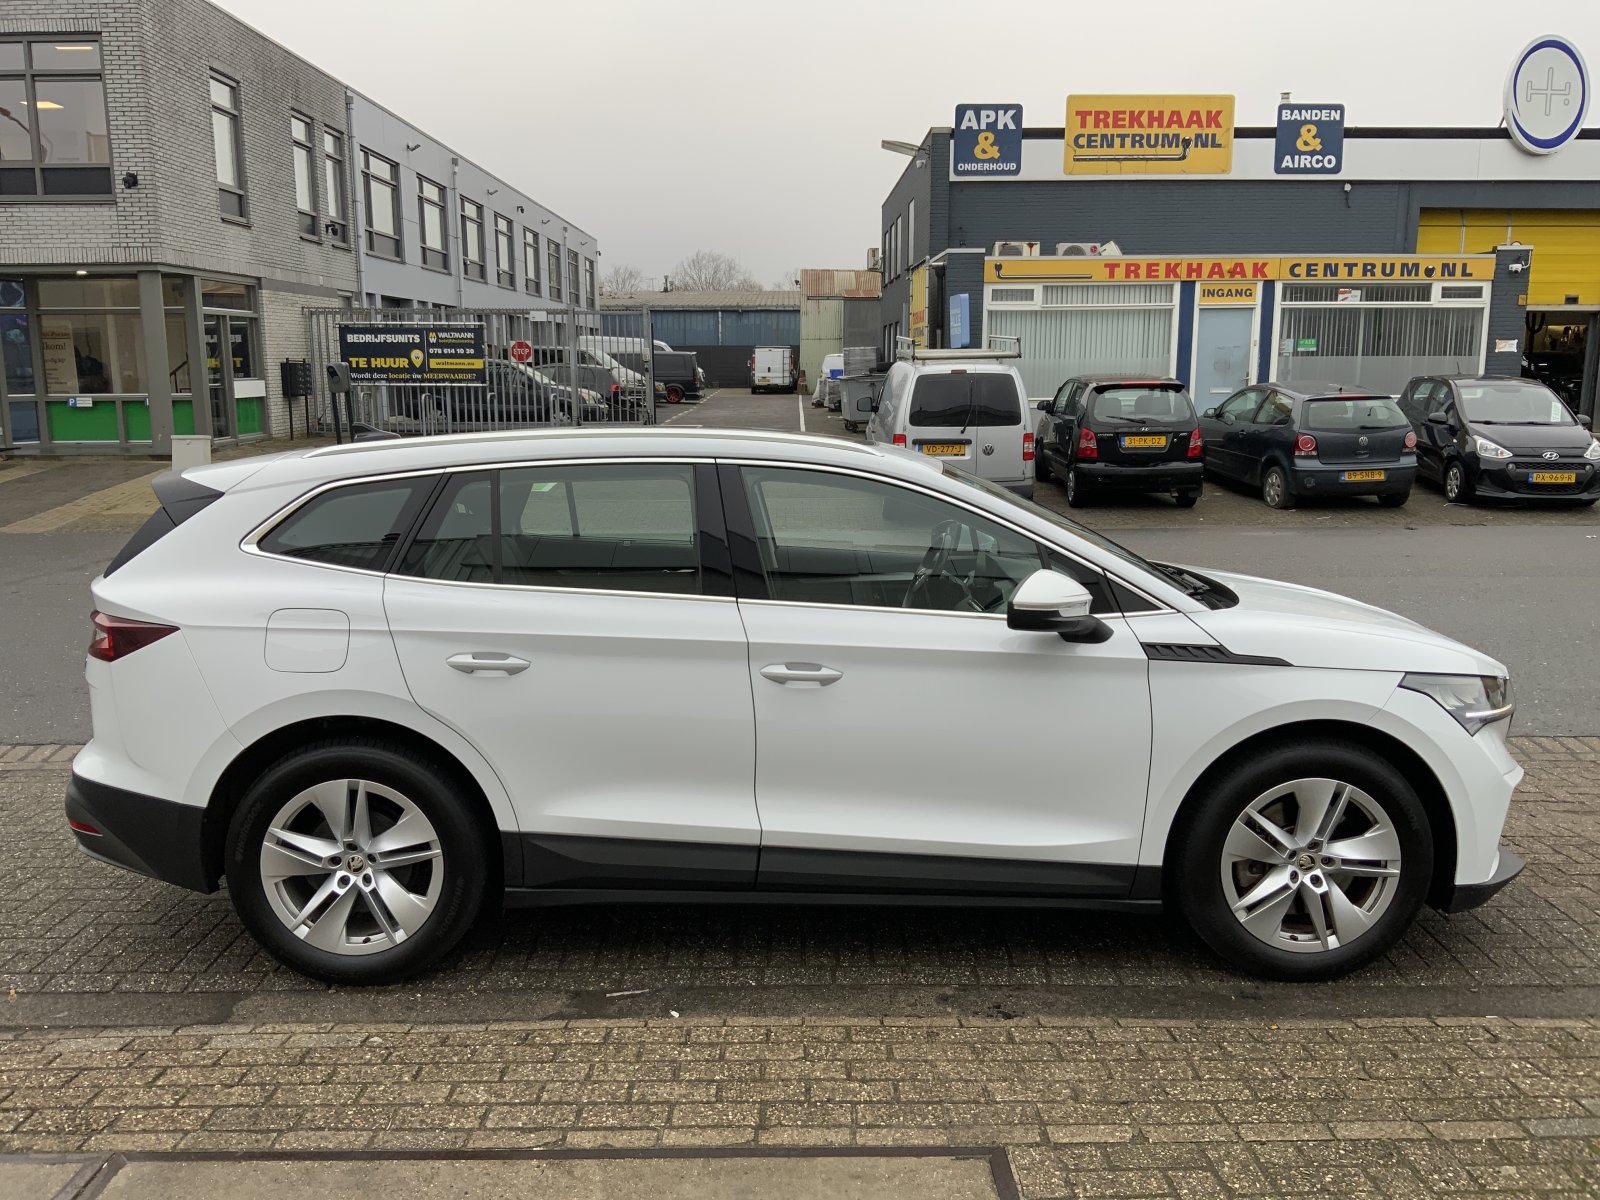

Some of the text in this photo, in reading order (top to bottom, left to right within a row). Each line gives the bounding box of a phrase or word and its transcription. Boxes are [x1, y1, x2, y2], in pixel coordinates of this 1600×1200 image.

[960, 110, 1017, 130] APK
[1074, 110, 1223, 129] TREKHAAK
[1281, 109, 1341, 121] BANDEN
[1295, 124, 1322, 151] &
[973, 131, 1000, 160] &
[957, 162, 1017, 172] ONDERHOUD
[1281, 154, 1336, 169] AIRCO
[1103, 262, 1269, 280] TREKHAAK
[1202, 287, 1253, 298] INGANG
[346, 333, 420, 343] BEDRIJFSUNITS
[349, 357, 409, 368] TE HUUR
[1127, 437, 1162, 445] 31-PK-DZ
[926, 445, 962, 453] VD-277-J
[1347, 470, 1383, 480] 89-SNB-9
[1535, 473, 1573, 481] PX-969-R
